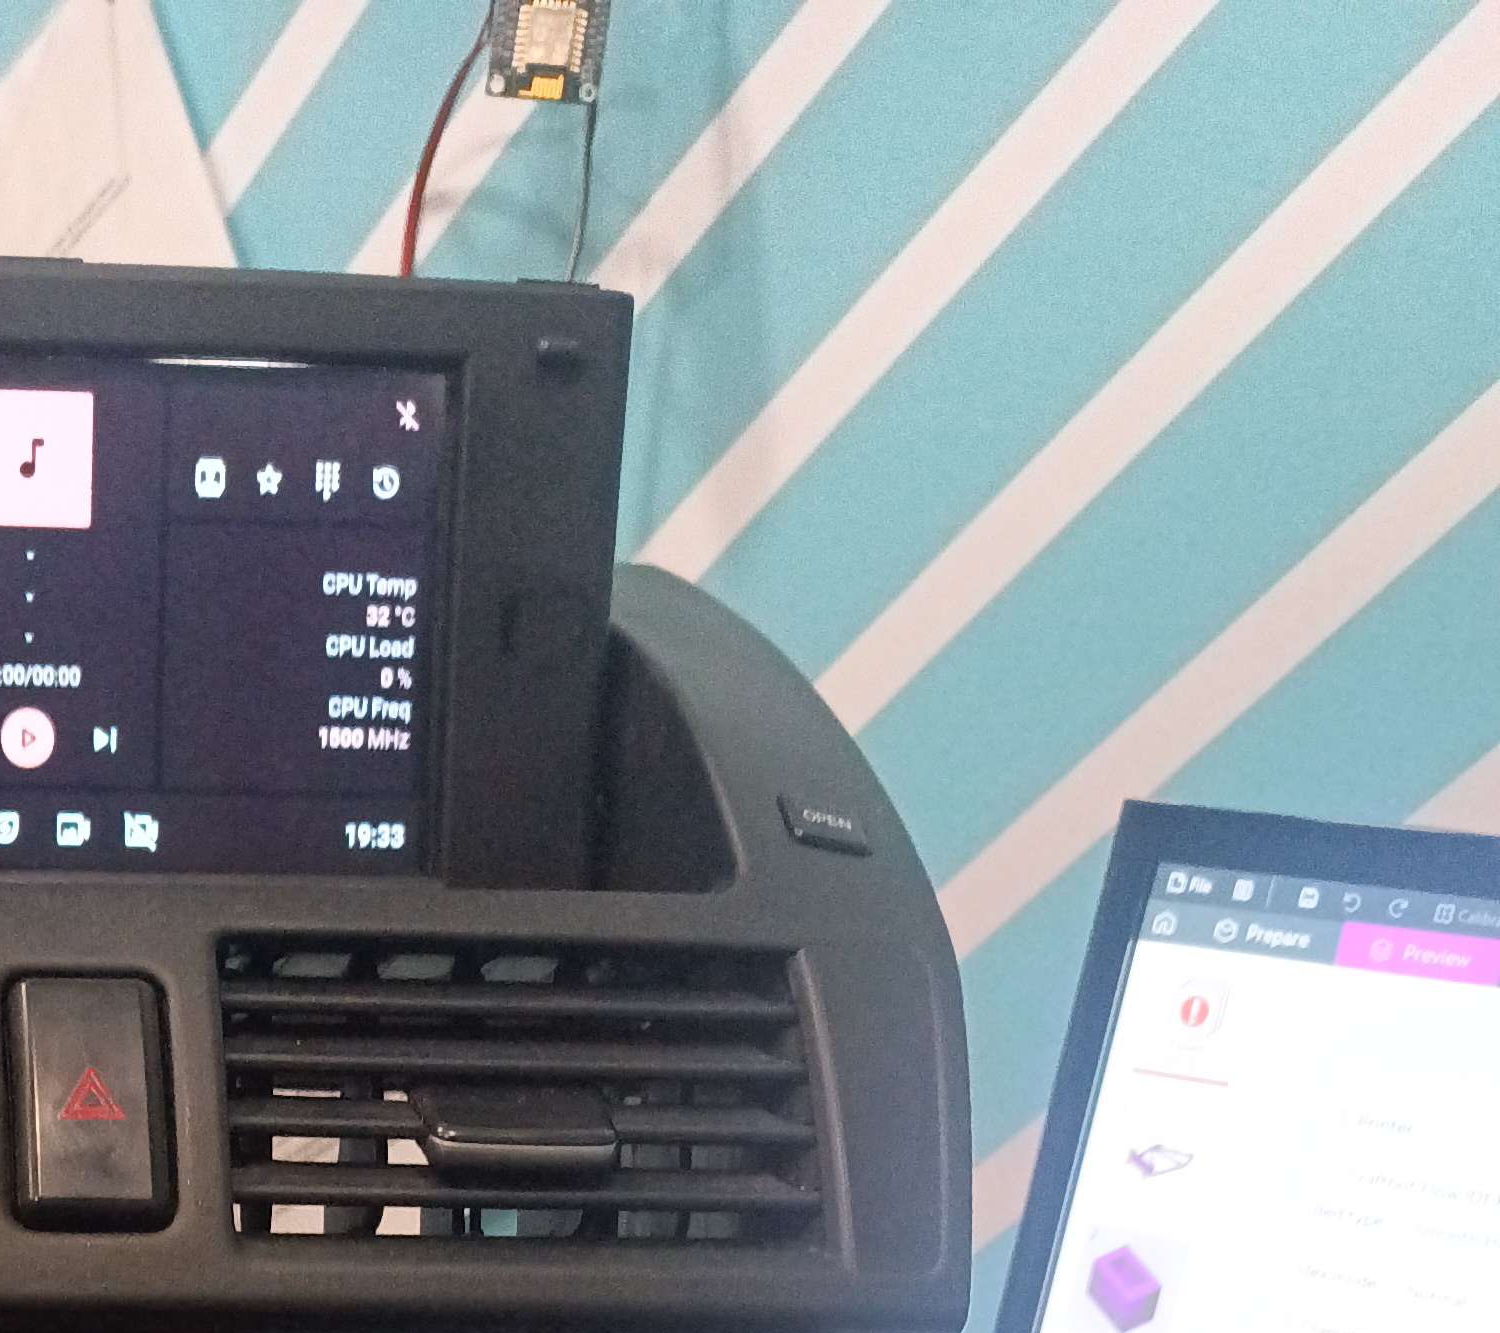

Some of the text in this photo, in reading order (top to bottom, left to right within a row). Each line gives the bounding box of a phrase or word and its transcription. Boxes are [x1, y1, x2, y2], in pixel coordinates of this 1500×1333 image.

[322, 571, 418, 602] CPU Temp
[325, 633, 415, 660] CPU Load
[380, 666, 394, 689] 0
[328, 695, 412, 725] CPU Freq
[367, 726, 412, 751] MHz
[344, 821, 406, 850] 19:33
[1245, 922, 1312, 949] Prepare
[1402, 943, 1473, 968] Preview
